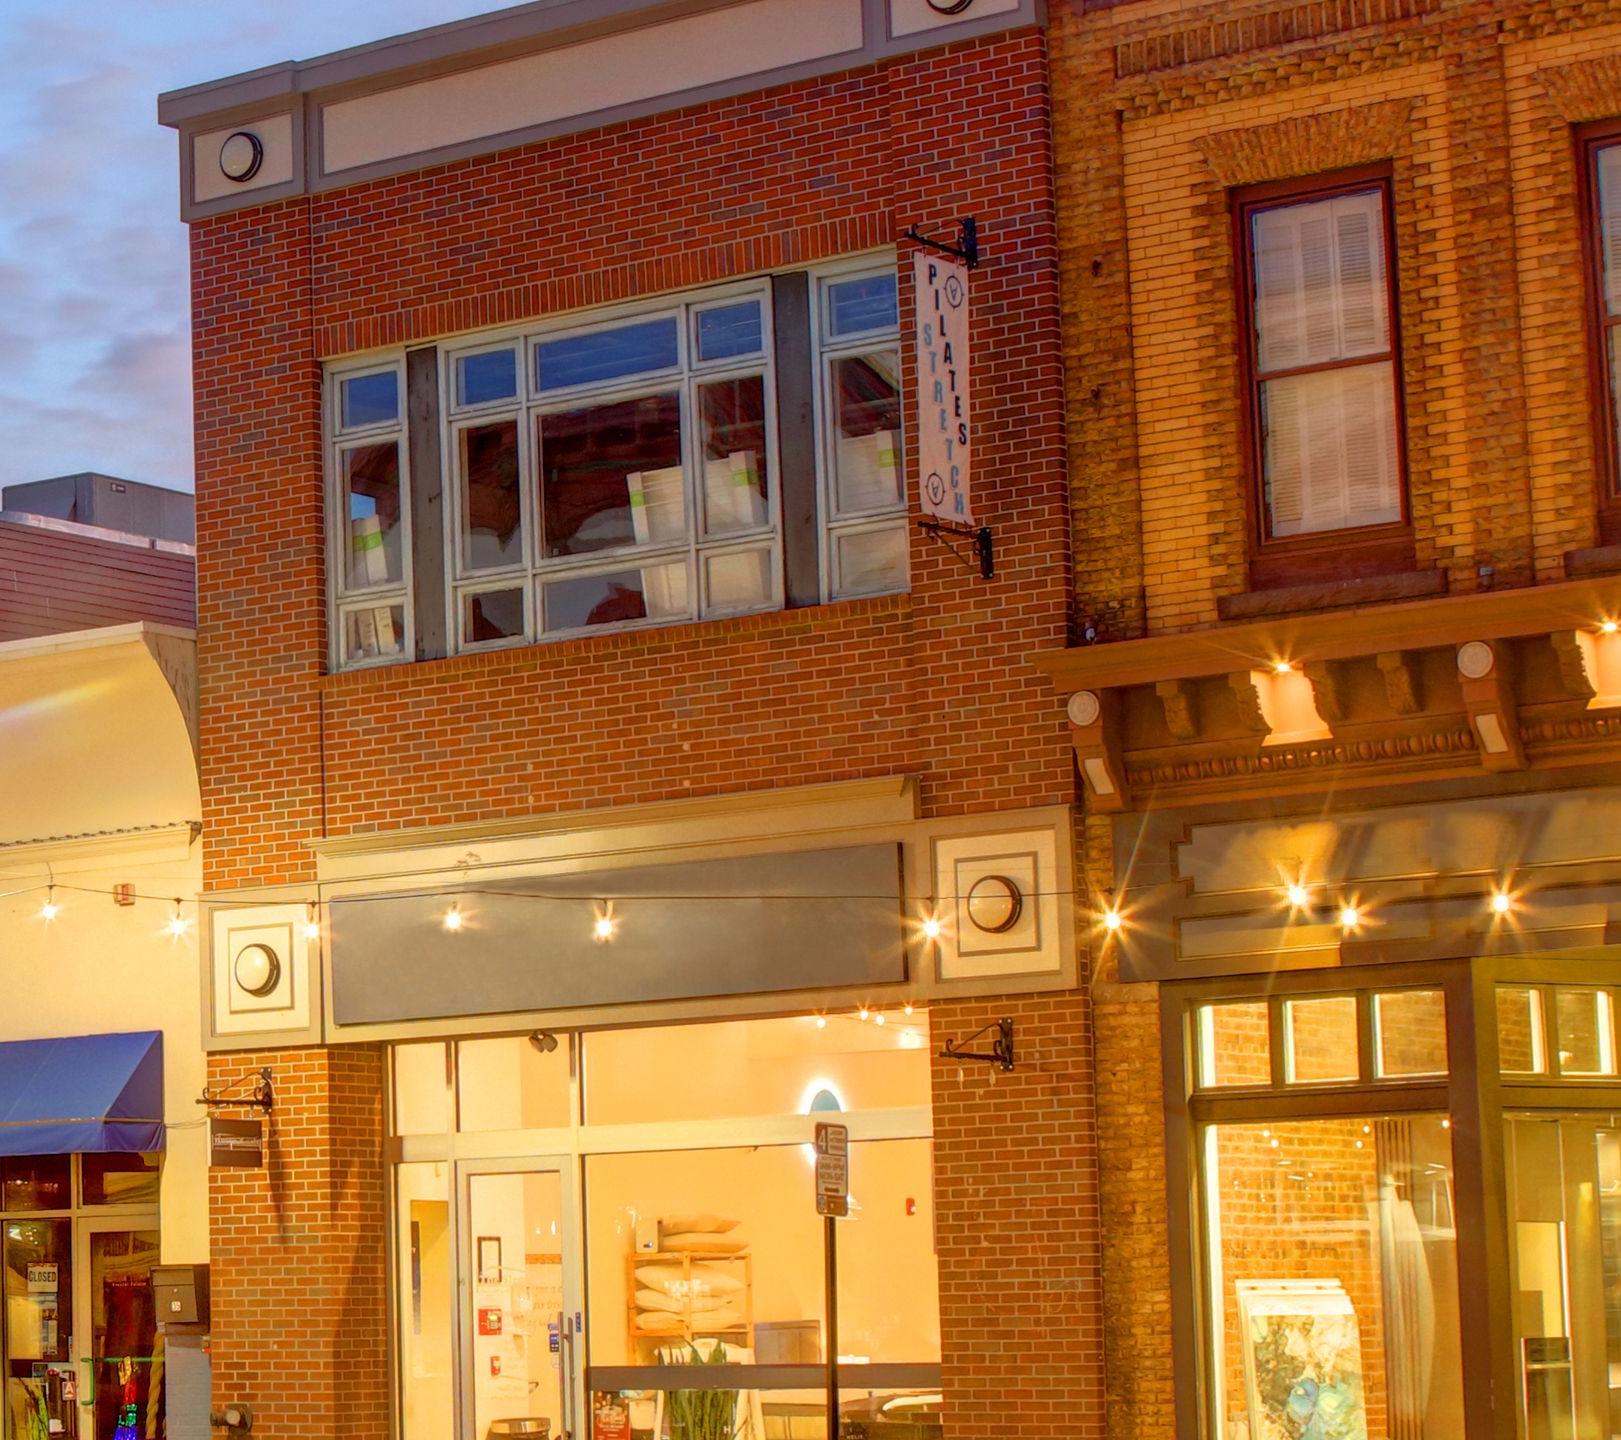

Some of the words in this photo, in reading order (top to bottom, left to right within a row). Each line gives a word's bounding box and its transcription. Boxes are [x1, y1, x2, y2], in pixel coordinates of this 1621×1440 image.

[922, 322, 965, 515] STRETCH
[928, 263, 968, 447] PILATES
[28, 1270, 57, 1282] CLOSED
